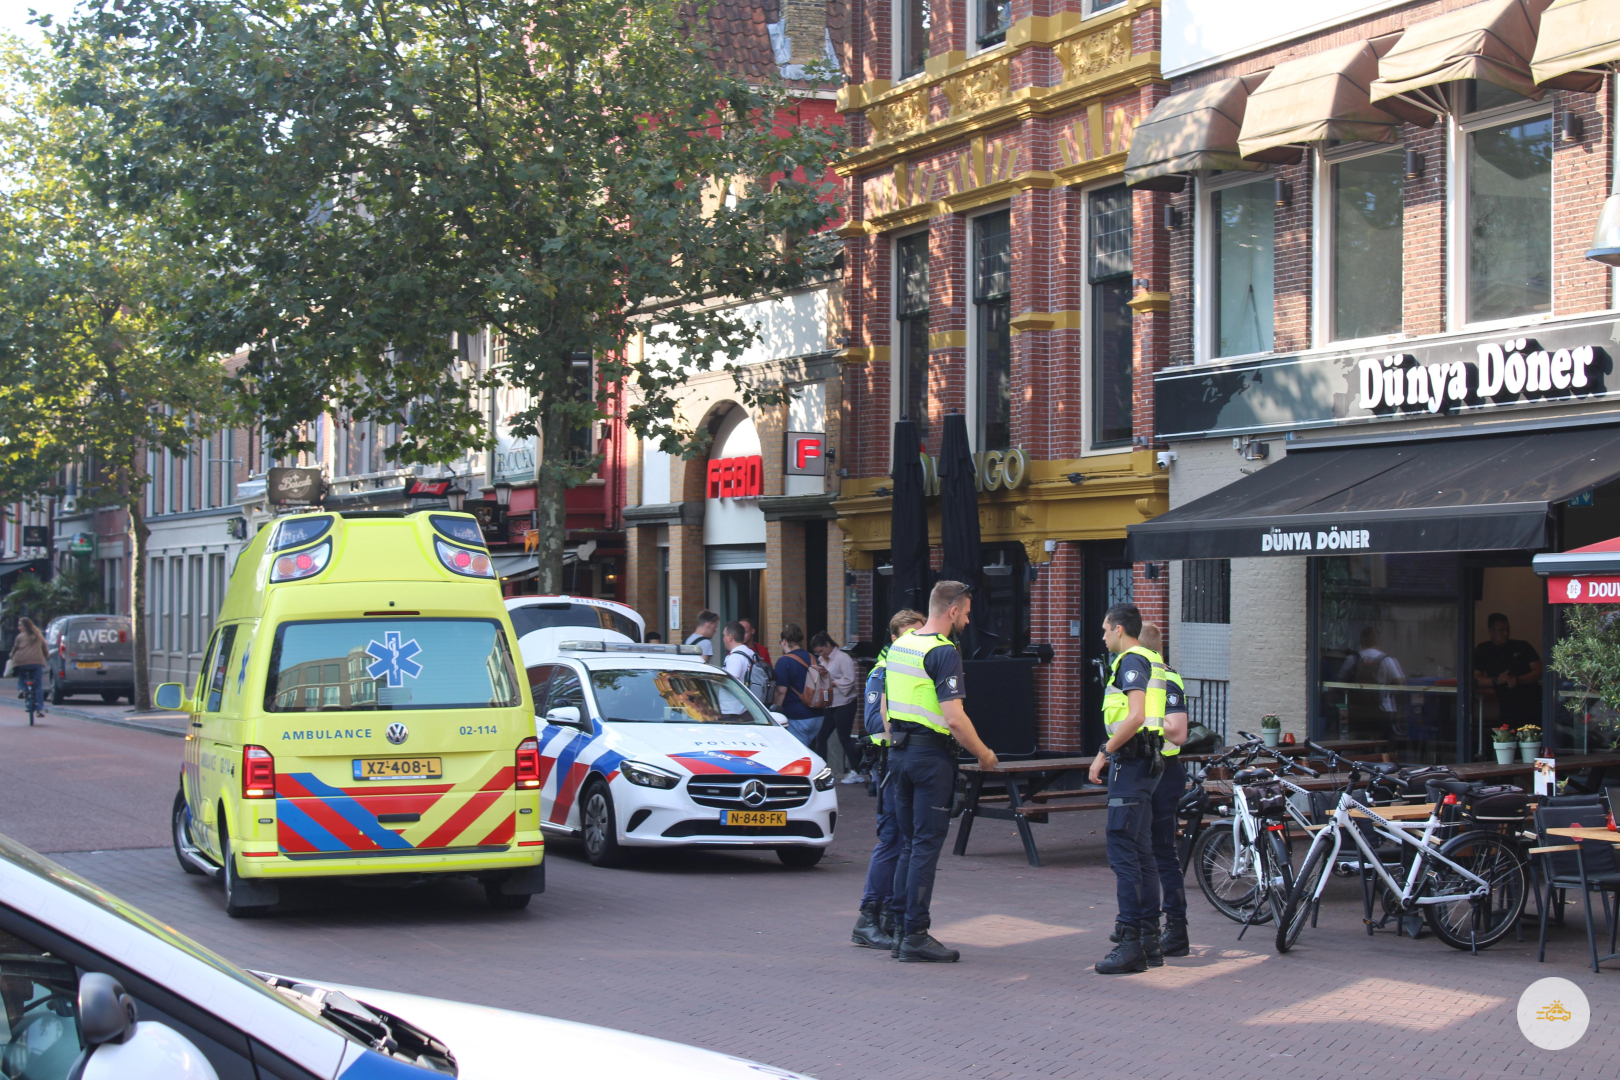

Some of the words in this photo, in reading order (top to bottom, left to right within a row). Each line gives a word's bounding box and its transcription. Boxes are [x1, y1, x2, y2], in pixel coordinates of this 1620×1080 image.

[1359, 353, 1468, 413] Dünya
[1477, 338, 1594, 397] Döner
[794, 438, 821, 469] F
[707, 455, 763, 498] FEBO
[417, 482, 439, 493] Bud
[1261, 528, 1312, 551] DÜNYA
[1316, 526, 1370, 550] DÖNER
[1588, 581, 1620, 598] DOU
[77, 629, 118, 643] AVEC
[281, 729, 373, 741] AMBULANCE
[459, 725, 498, 736] 02-114
[731, 811, 784, 825] N-848-FK
